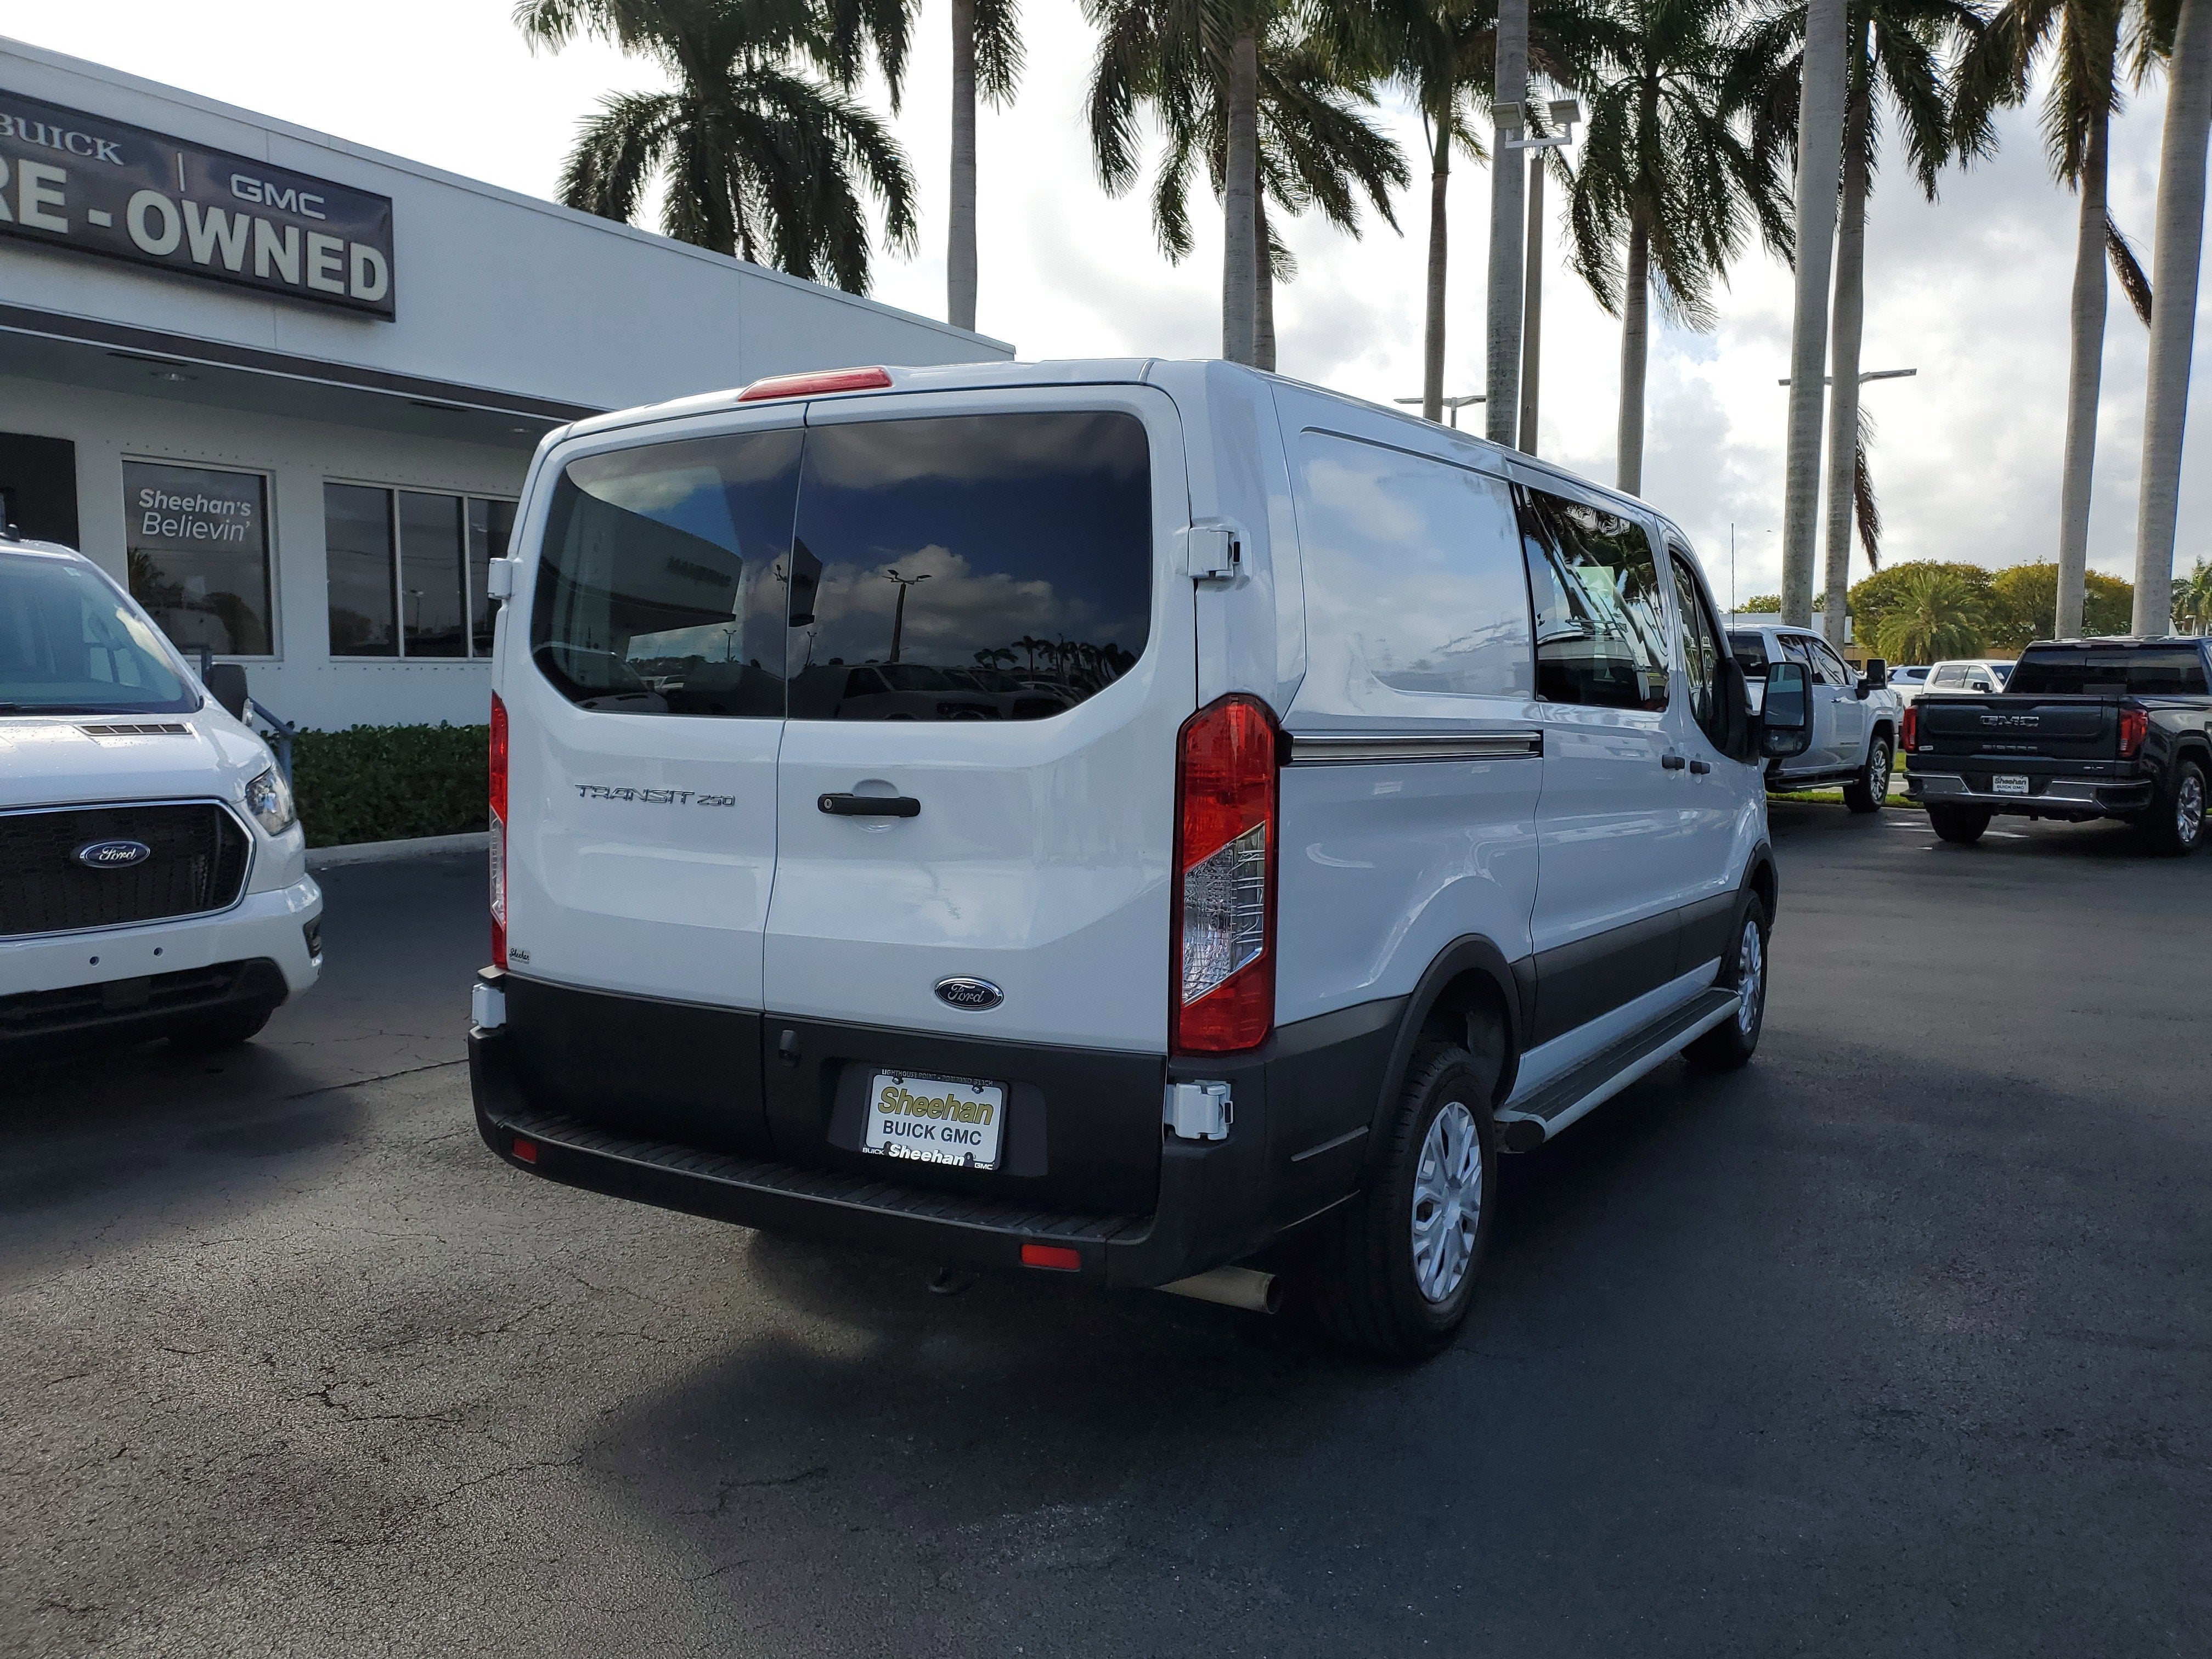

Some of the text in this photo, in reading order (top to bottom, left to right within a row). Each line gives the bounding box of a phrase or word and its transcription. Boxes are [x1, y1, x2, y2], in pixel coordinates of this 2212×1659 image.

[230, 173, 326, 221] GMC
[0, 155, 388, 302] E-OWNED
[139, 488, 251, 517] Sheehan's
[142, 511, 251, 542] Believin'
[1980, 715, 2039, 727] GMC
[575, 784, 735, 806] TRANSIT 250
[99, 845, 137, 861] Ford
[947, 984, 984, 1003] Ford
[882, 1069, 917, 1078] LIGHTHOUSE
[878, 1086, 994, 1125] Sheehan
[883, 1120, 982, 1146] BUICK GMC
[862, 1144, 994, 1170] BUICK Sheehan GMC
